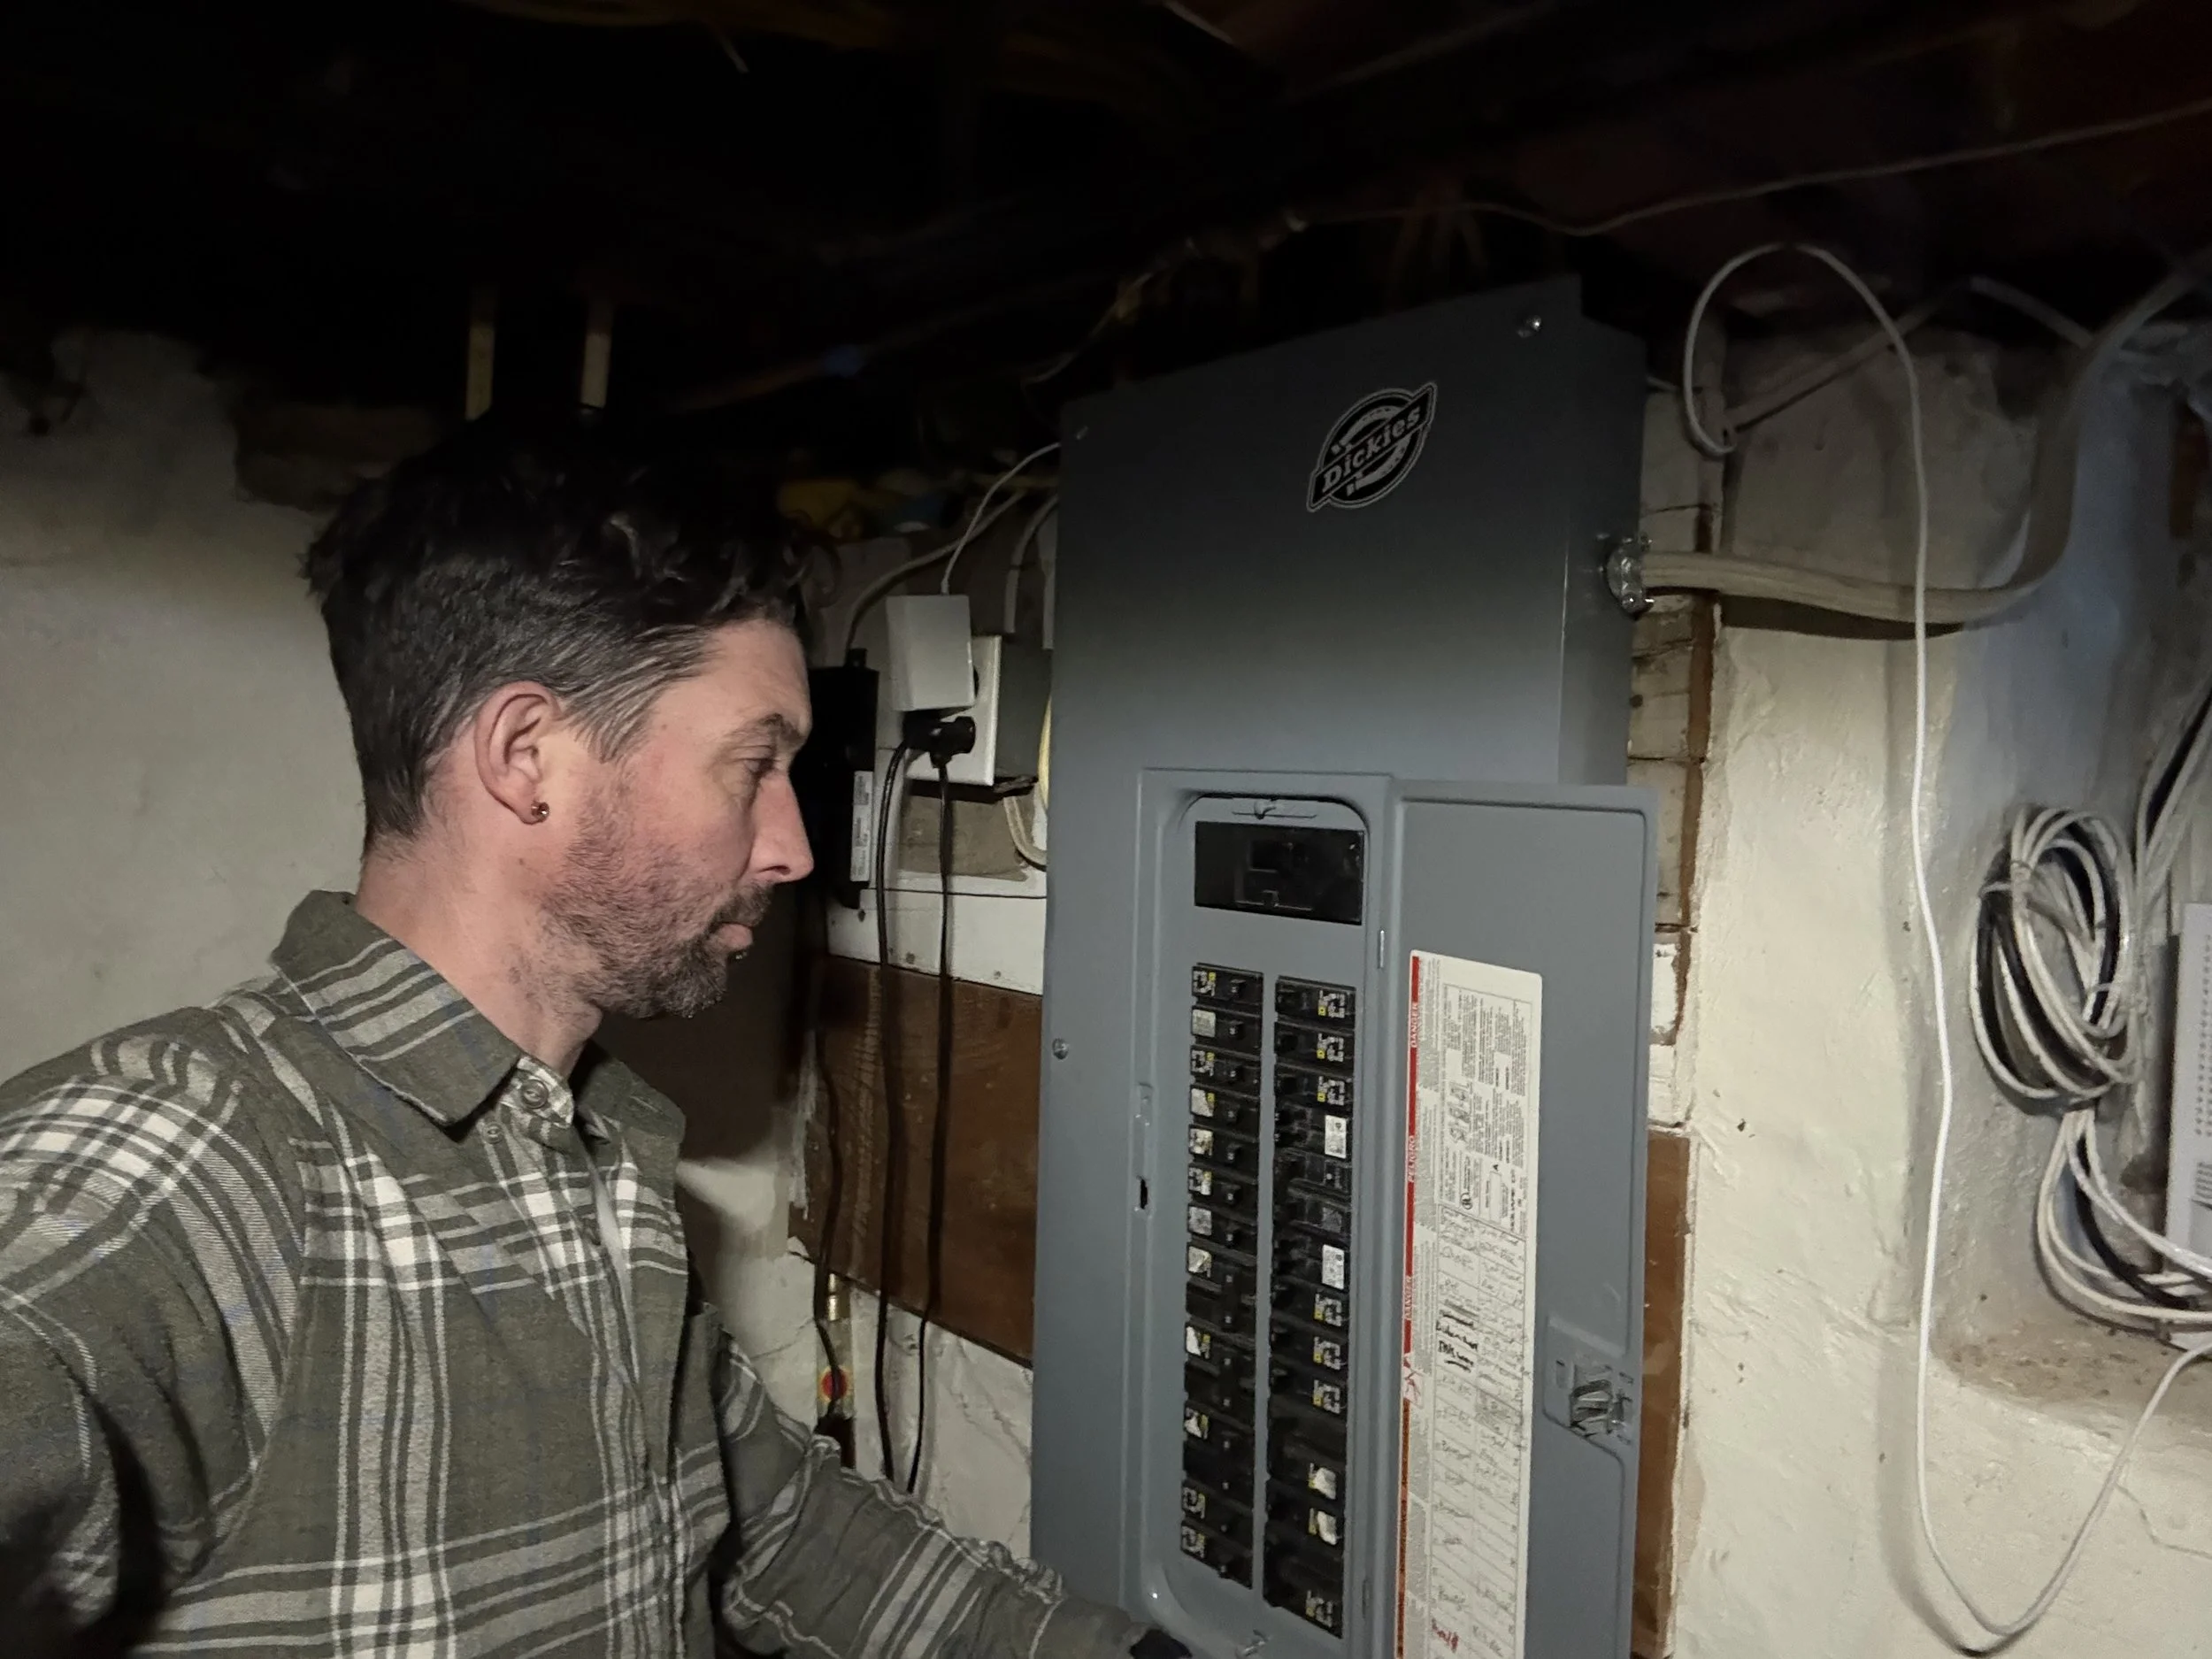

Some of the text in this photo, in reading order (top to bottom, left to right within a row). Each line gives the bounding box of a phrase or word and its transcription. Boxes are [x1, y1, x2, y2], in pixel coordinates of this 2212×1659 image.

[1321, 406, 1421, 493] Dickies
[1410, 1002, 1419, 1049] DANGER
[1407, 1136, 1416, 1183] PELIGRO
